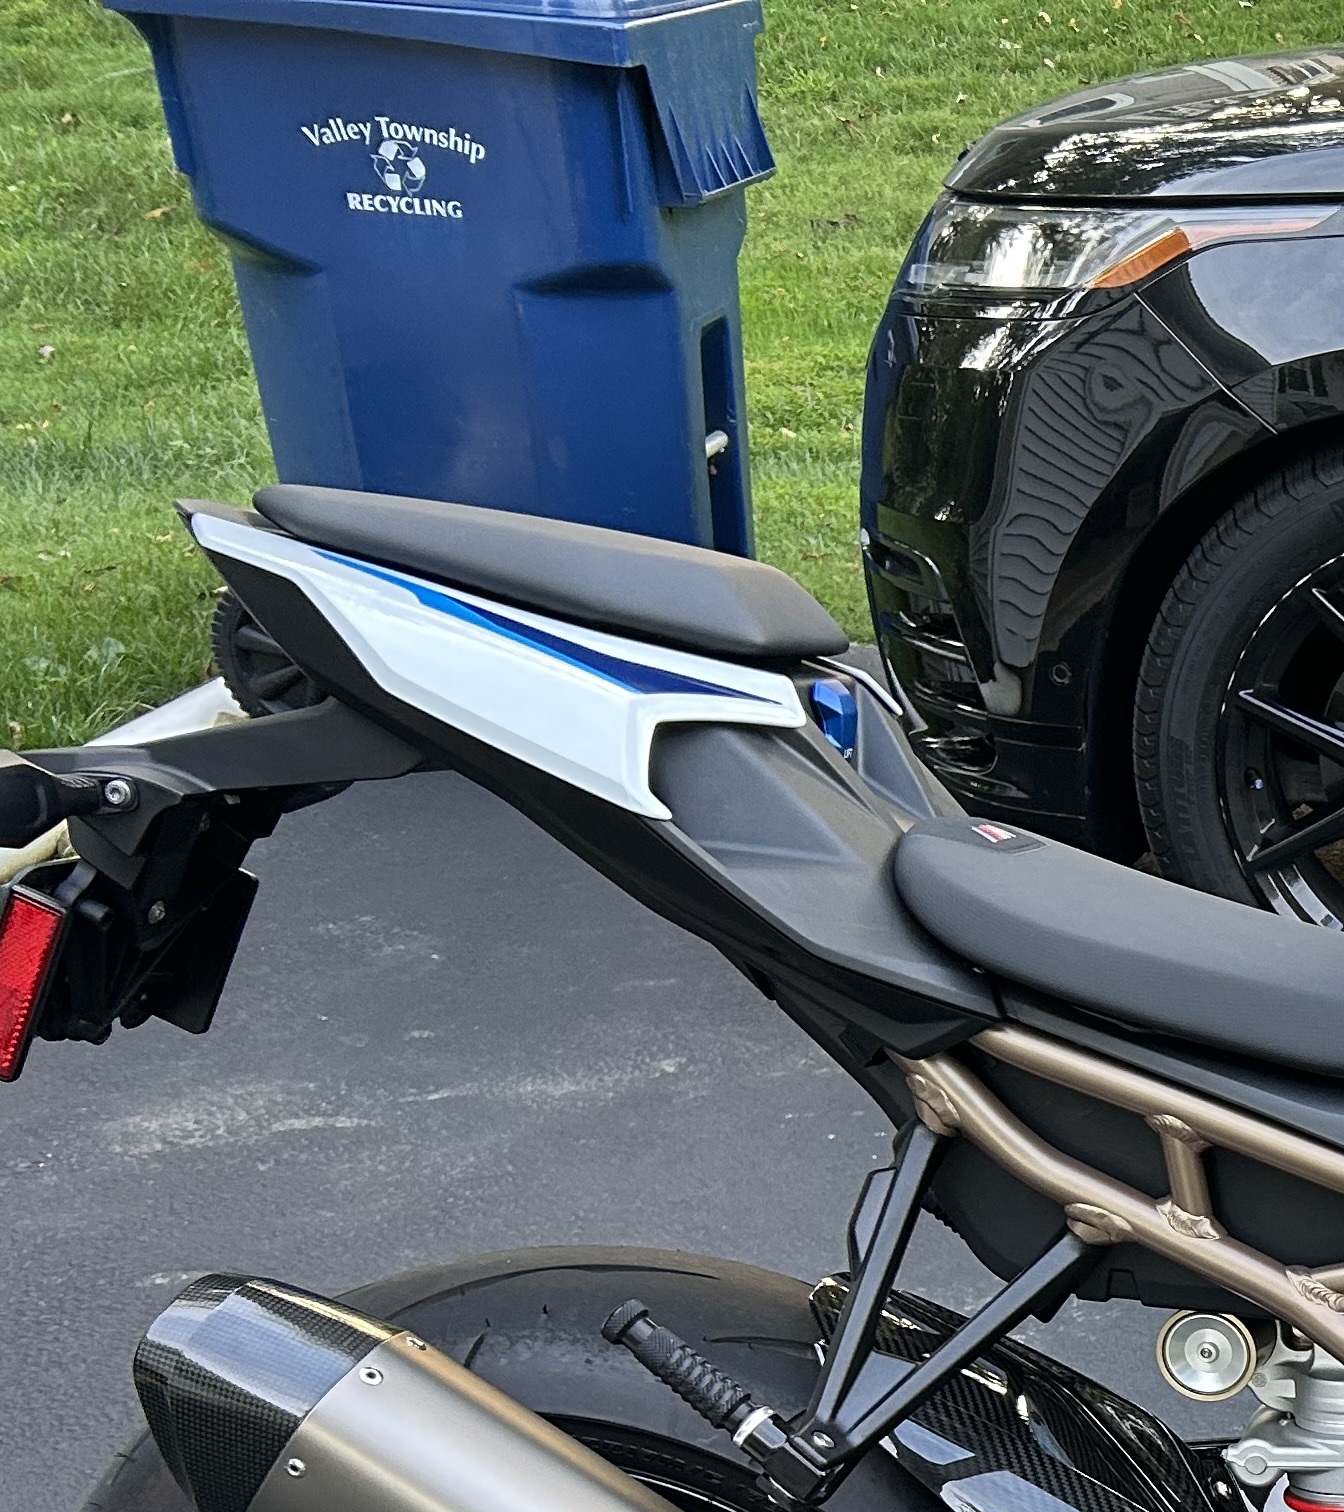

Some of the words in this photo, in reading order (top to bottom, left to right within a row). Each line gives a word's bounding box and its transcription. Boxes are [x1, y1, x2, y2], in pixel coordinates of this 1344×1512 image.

[301, 118, 371, 146] Valley
[374, 116, 485, 164] Township
[347, 192, 463, 218] RECYCLING
